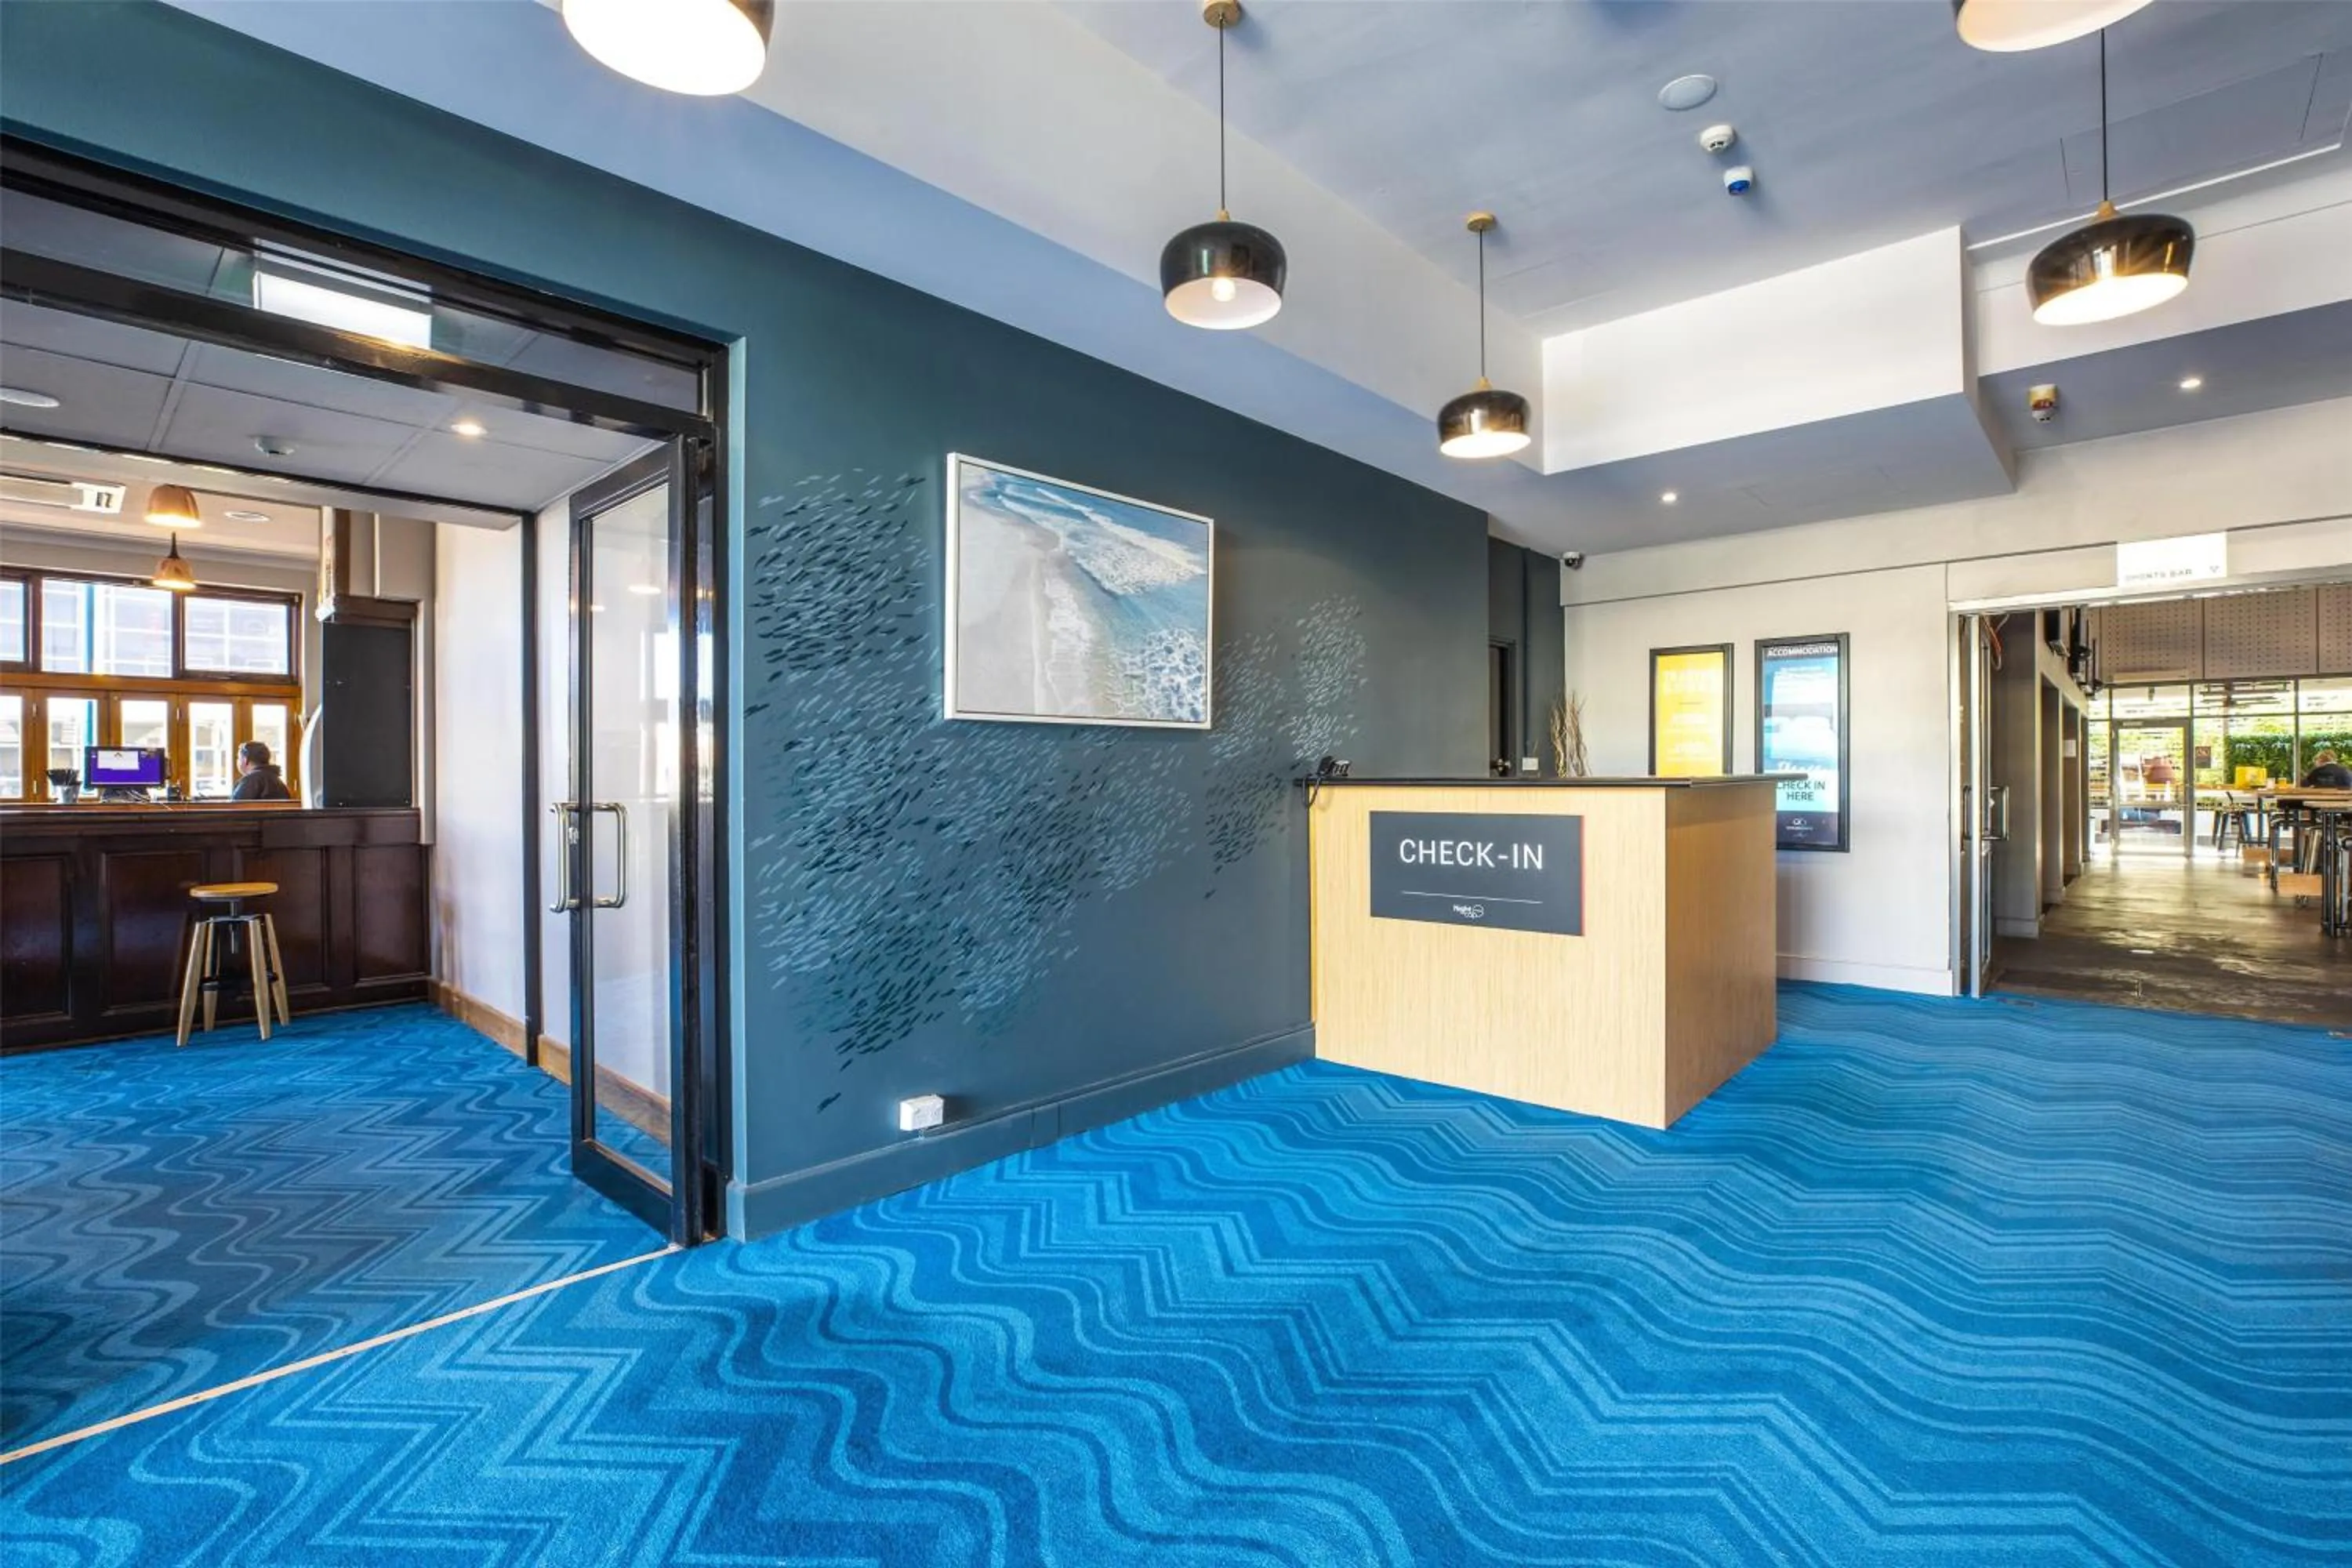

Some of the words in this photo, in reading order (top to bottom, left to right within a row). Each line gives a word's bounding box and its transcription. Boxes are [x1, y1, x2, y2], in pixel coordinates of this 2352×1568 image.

[1768, 644, 1838, 656] ACCOMMODATION
[1813, 780, 1825, 790] IN
[1787, 791, 1813, 800] HERE
[1399, 838, 1543, 869] CHECK-IN
